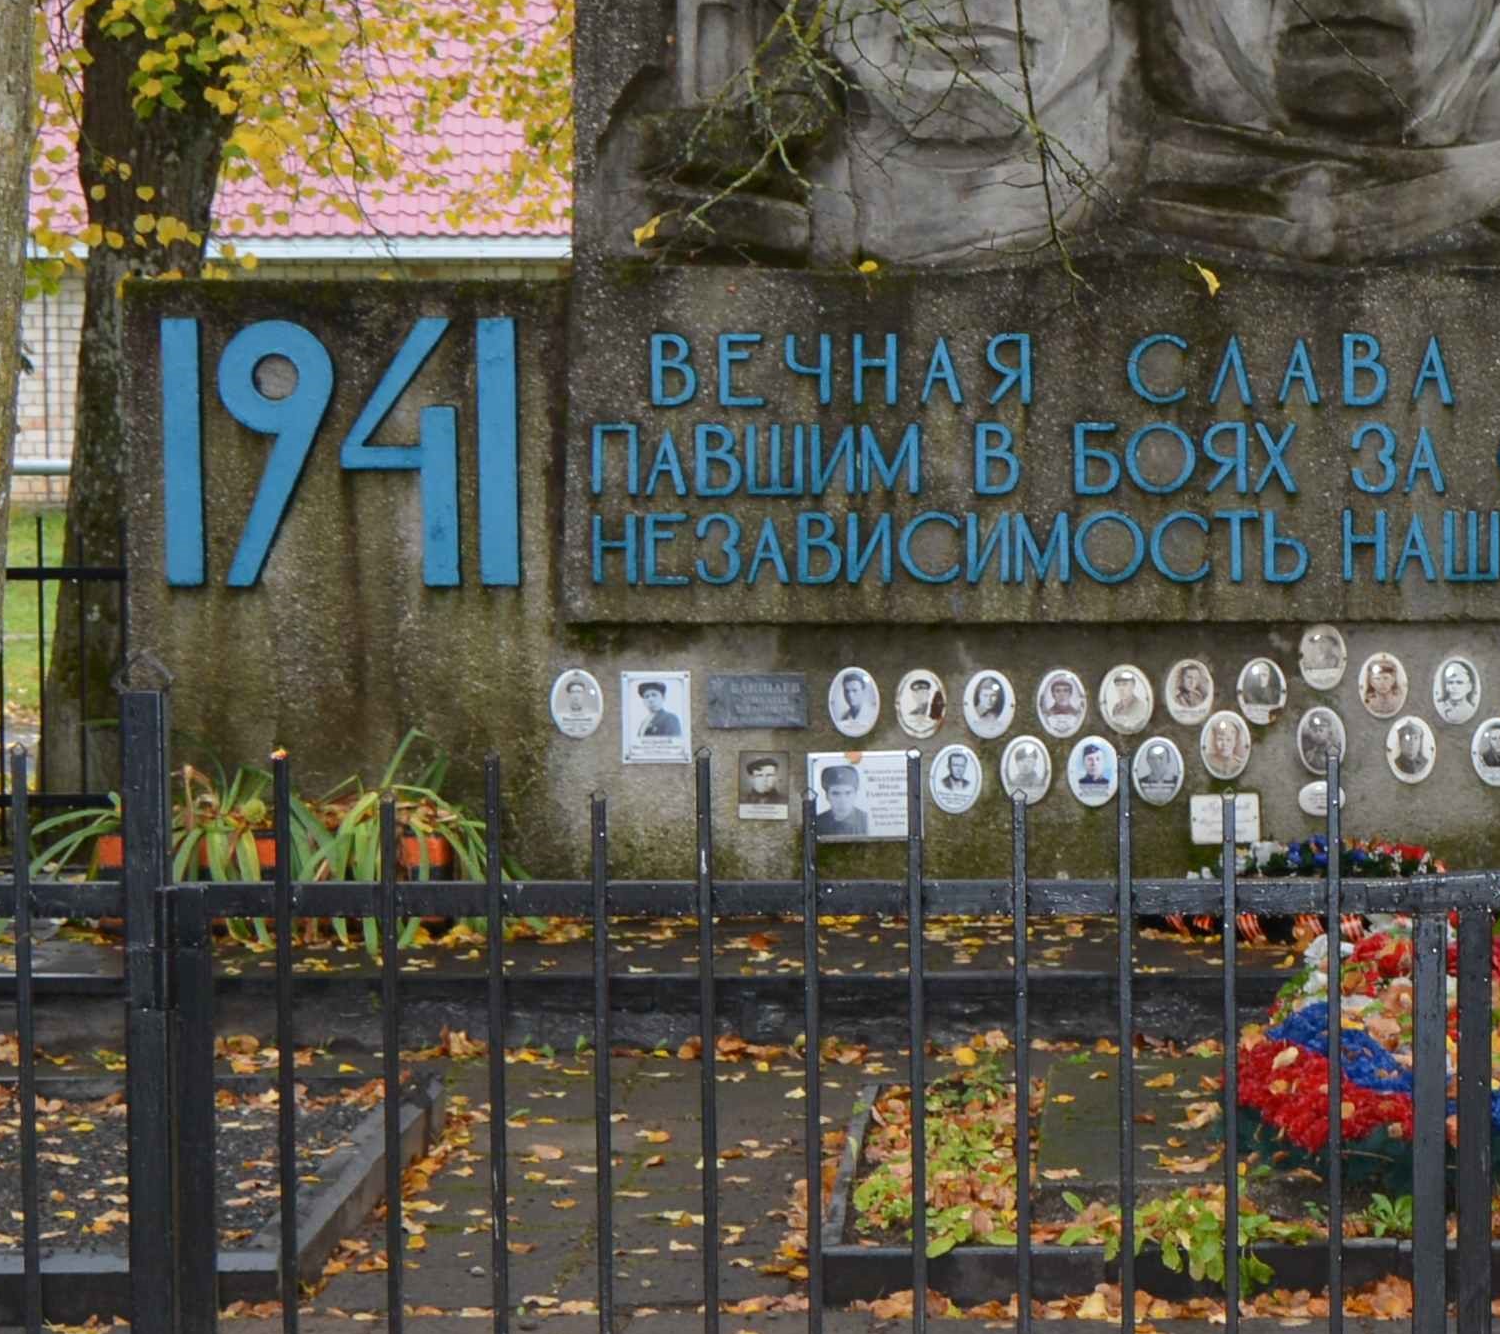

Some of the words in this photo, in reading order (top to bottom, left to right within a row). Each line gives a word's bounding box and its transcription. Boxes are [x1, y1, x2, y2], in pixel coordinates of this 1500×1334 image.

[651, 331, 1033, 407] ВЕЧНАЯ
[1128, 333, 1455, 407] СЛАВА
[159, 316, 521, 587] 1941
[591, 422, 921, 497] ПАВШИМ
[975, 422, 1021, 496] В
[1073, 421, 1297, 496] БОЯХ
[1351, 422, 1444, 495] ЗА
[592, 510, 1310, 585] НЕЗАВИСИМОСТЬ
